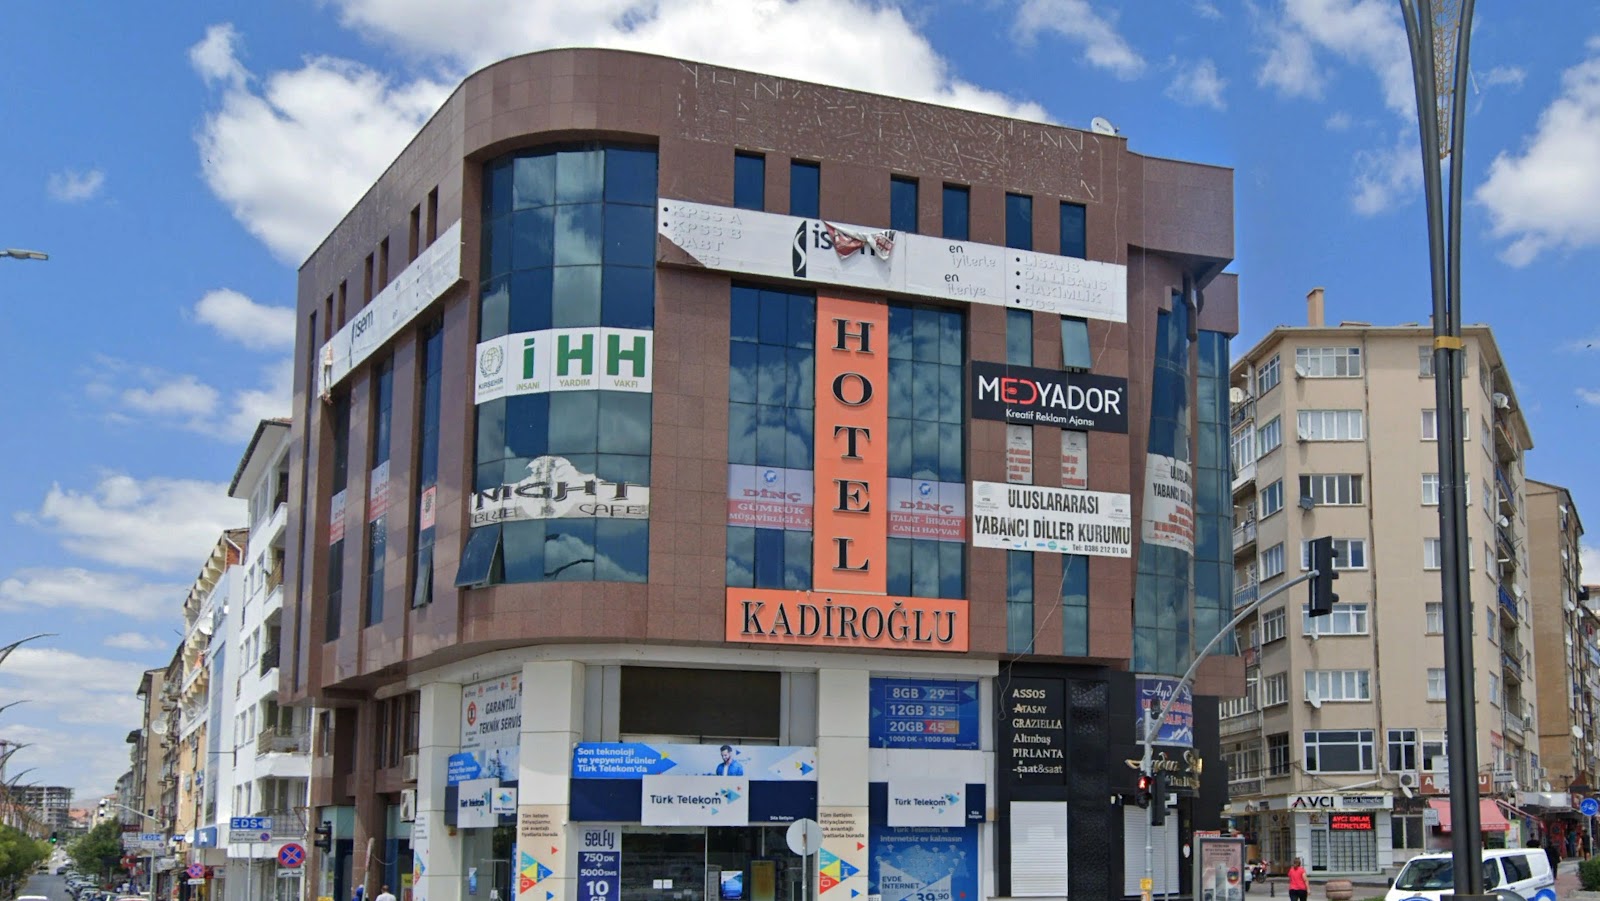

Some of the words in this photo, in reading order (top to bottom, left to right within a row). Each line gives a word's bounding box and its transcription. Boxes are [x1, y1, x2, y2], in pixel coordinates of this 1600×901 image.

[949, 244, 964, 254] en
[944, 273, 959, 283] en
[559, 378, 591, 388] YARDIM
[613, 379, 639, 388] VAKFI
[978, 374, 1121, 416] MEDYADOR
[1005, 408, 1034, 421] Kreatif
[1035, 411, 1067, 424] Reklam
[1068, 415, 1095, 428] Ajansı
[831, 317, 876, 573] HOTEL
[743, 488, 802, 503] DİNÇ
[1008, 488, 1099, 515] ULUSLARARASI
[578, 503, 643, 517] CAFE
[737, 503, 805, 515] GÜMRÜK
[899, 500, 954, 515] DİNÇ
[729, 512, 794, 525] MÜŞAVİRLİĞİ
[892, 524, 921, 533] CANLI
[922, 526, 960, 536] HAYVAN
[975, 514, 1029, 538] YABANCI
[1033, 516, 1074, 541] DİLLER
[1078, 523, 1130, 545] KURUMU
[1100, 546, 1111, 554] 212
[740, 597, 957, 644] KADİROĞLU
[892, 688, 919, 699] 8GB
[929, 689, 945, 699] 29
[1012, 689, 1046, 699] ASSOS
[485, 694, 518, 715] GARANTİLİ
[889, 704, 924, 716] 12GB
[929, 705, 945, 716] 35
[479, 717, 500, 734] TEKNİK
[500, 713, 522, 731] SERVİS
[889, 721, 924, 732] 20GB
[928, 722, 945, 733] 45
[1012, 718, 1063, 729] GRAZIELLA
[1013, 733, 1052, 745] Altınbaş
[577, 747, 594, 756] Son
[596, 748, 635, 757] teknoloji
[589, 757, 623, 765] yepyeni
[625, 757, 657, 765] ürünler
[599, 765, 648, 773] Telekom'da
[650, 794, 673, 804] Türk
[677, 795, 722, 805] Telekom
[894, 797, 912, 806] Türk
[913, 798, 946, 806] Telekom
[1291, 796, 1334, 807] AVCI
[232, 819, 258, 828] EDS
[583, 853, 604, 862] 750
[586, 880, 610, 896] 10
